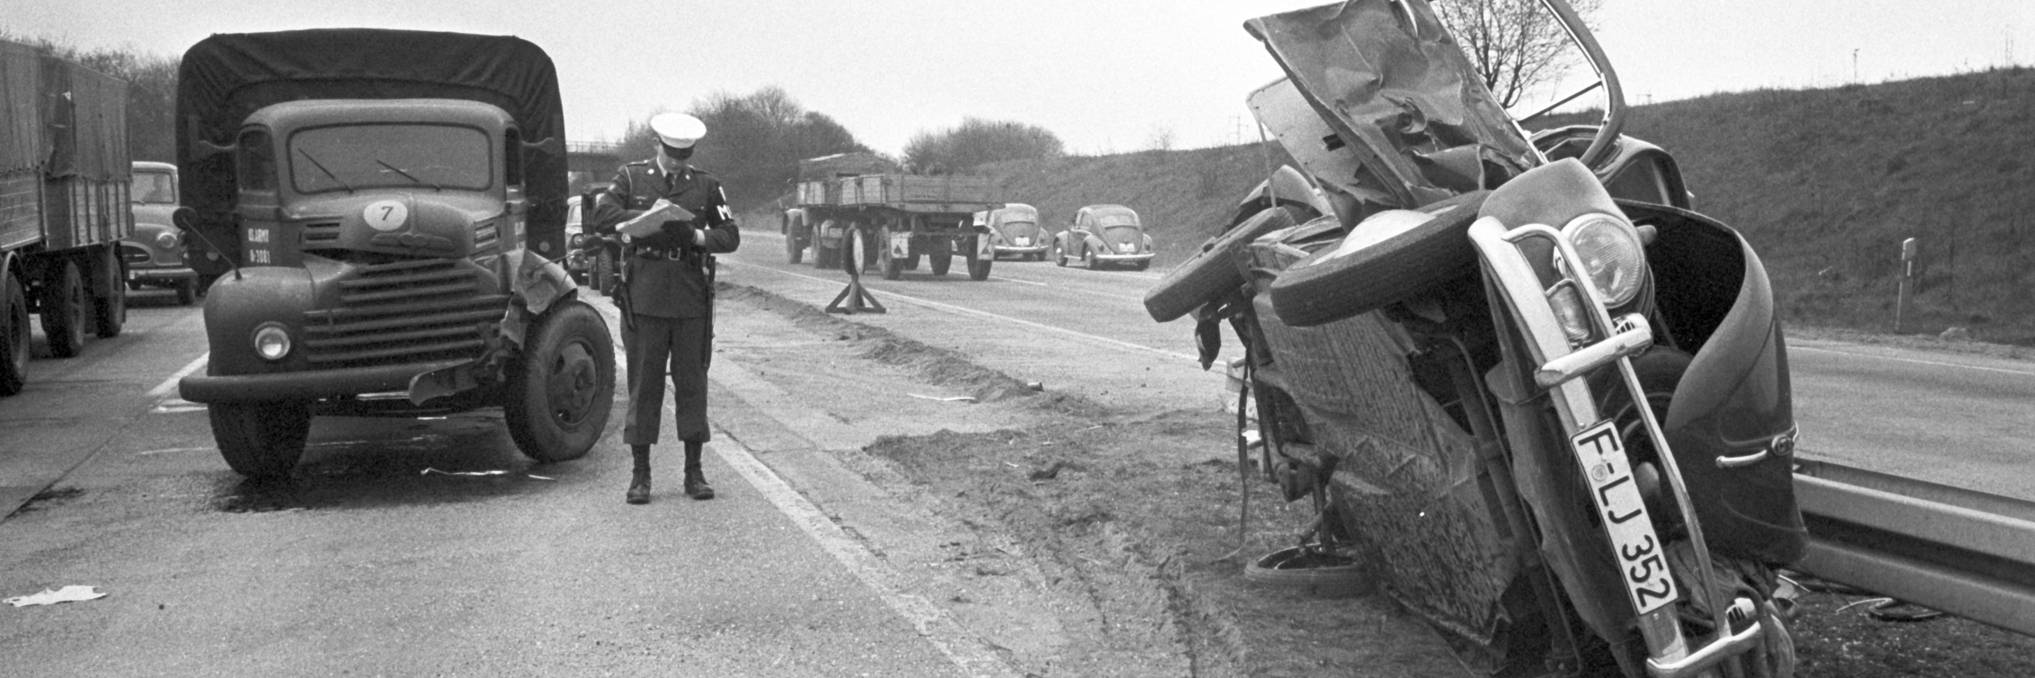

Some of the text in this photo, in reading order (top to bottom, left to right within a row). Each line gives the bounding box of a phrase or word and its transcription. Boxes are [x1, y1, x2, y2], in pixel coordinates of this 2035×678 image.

[381, 206, 394, 221] 7
[1578, 428, 1671, 608] F-LJ 352
